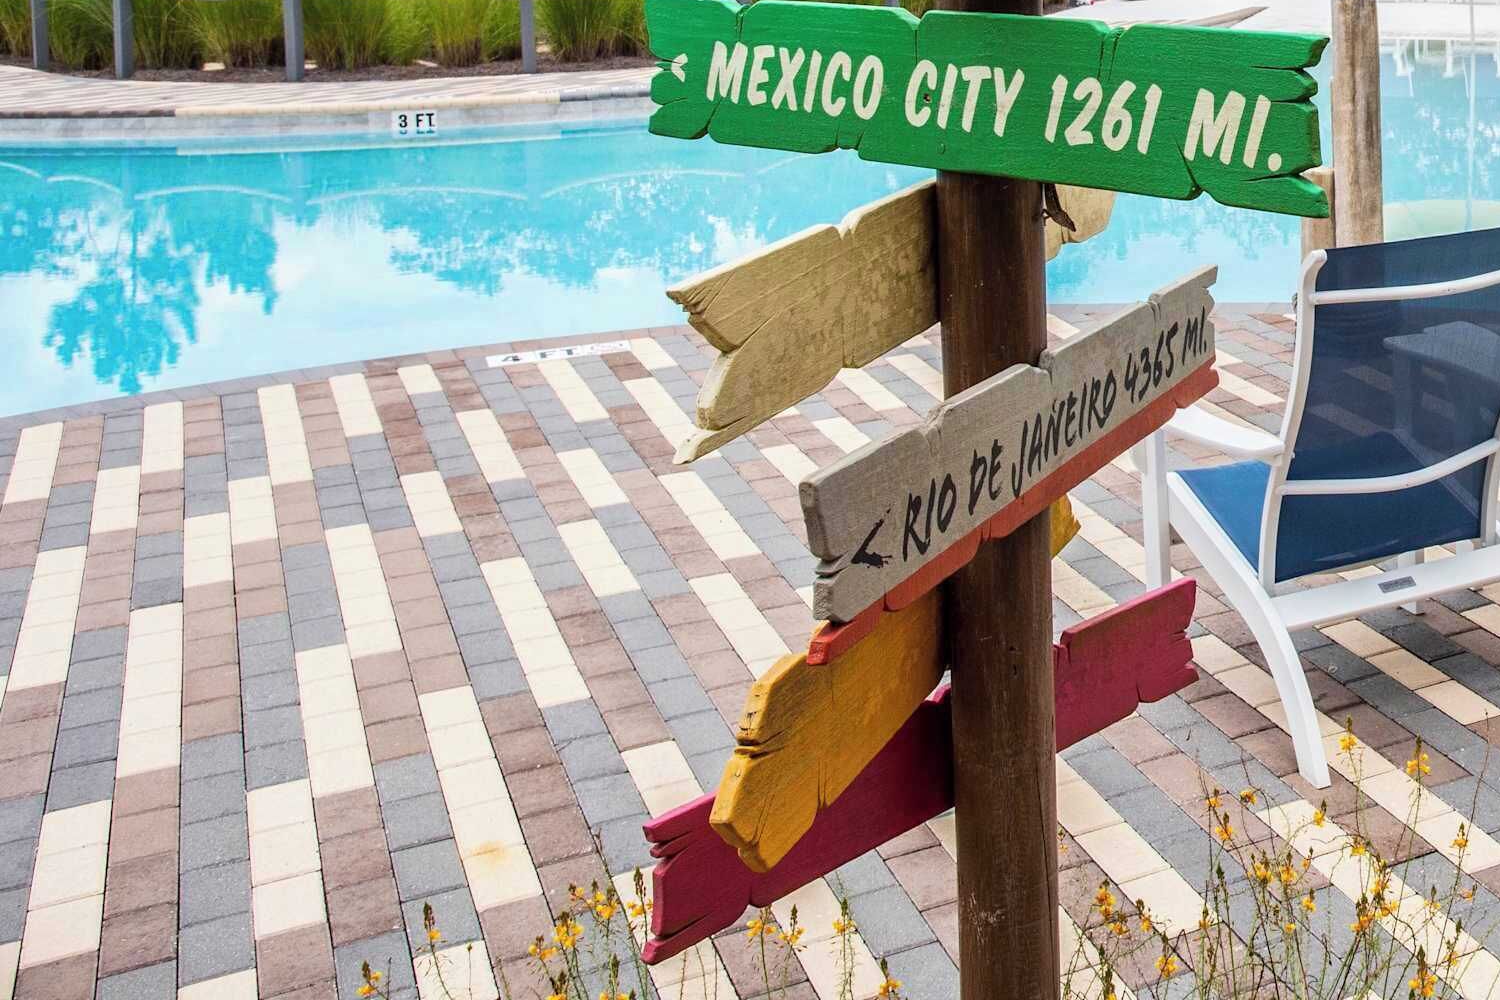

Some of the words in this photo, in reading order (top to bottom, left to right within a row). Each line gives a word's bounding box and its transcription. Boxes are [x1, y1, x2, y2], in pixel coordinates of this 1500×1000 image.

[398, 114, 408, 128] 3
[706, 40, 884, 120] MEXICO
[904, 59, 1025, 137] CITY
[1044, 74, 1163, 155] 1261
[1184, 87, 1283, 172] MI.
[902, 473, 957, 562] RIO
[968, 439, 1003, 516] DE
[1124, 321, 1178, 404] 4365
[1182, 305, 1207, 366] MI.
